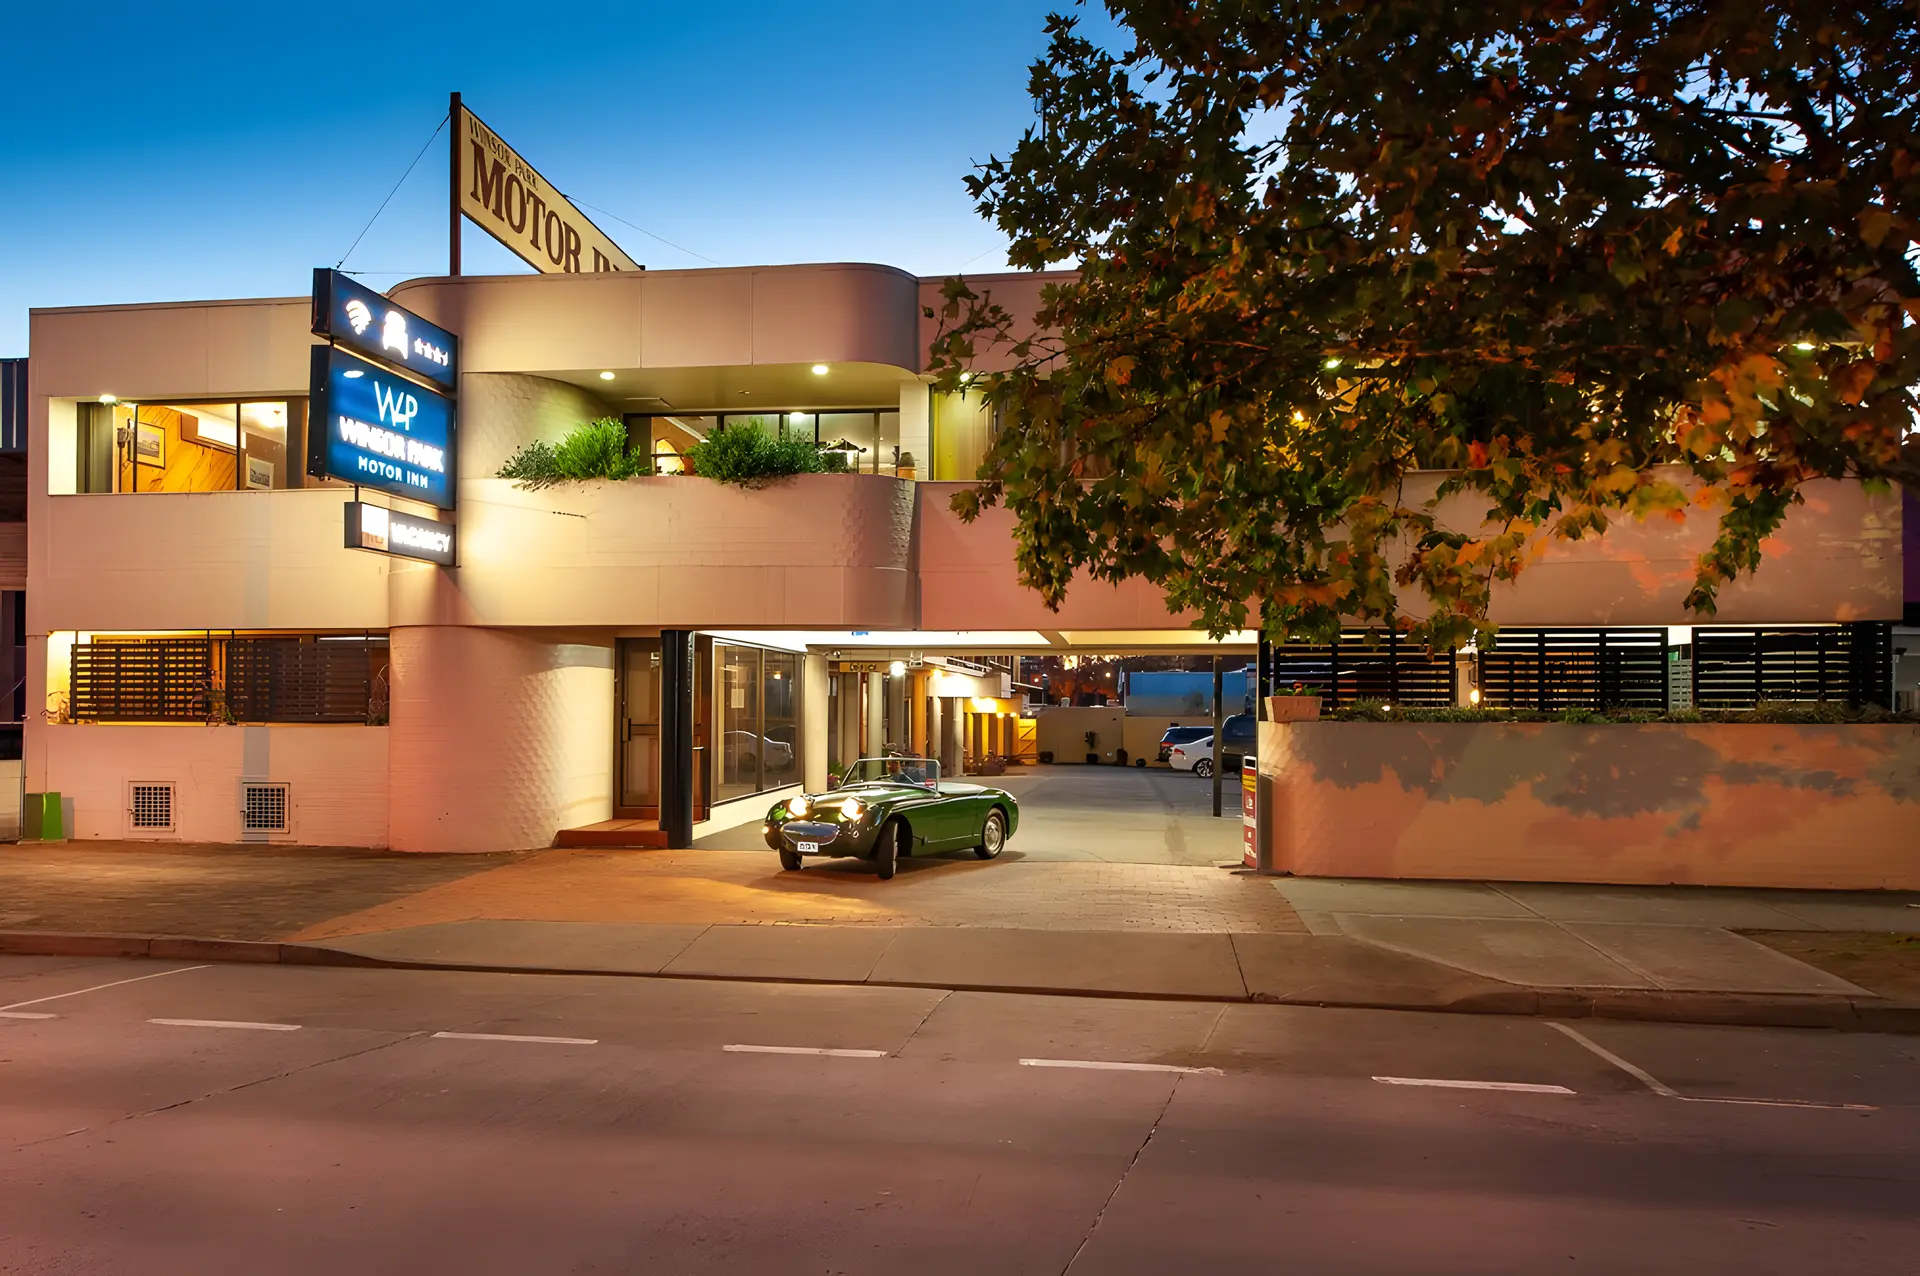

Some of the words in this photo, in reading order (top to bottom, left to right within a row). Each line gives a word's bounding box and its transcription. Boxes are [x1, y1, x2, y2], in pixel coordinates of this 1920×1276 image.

[470, 138, 582, 274] MOTOR
[358, 455, 403, 482] MOTOR
[406, 470, 429, 489] INN
